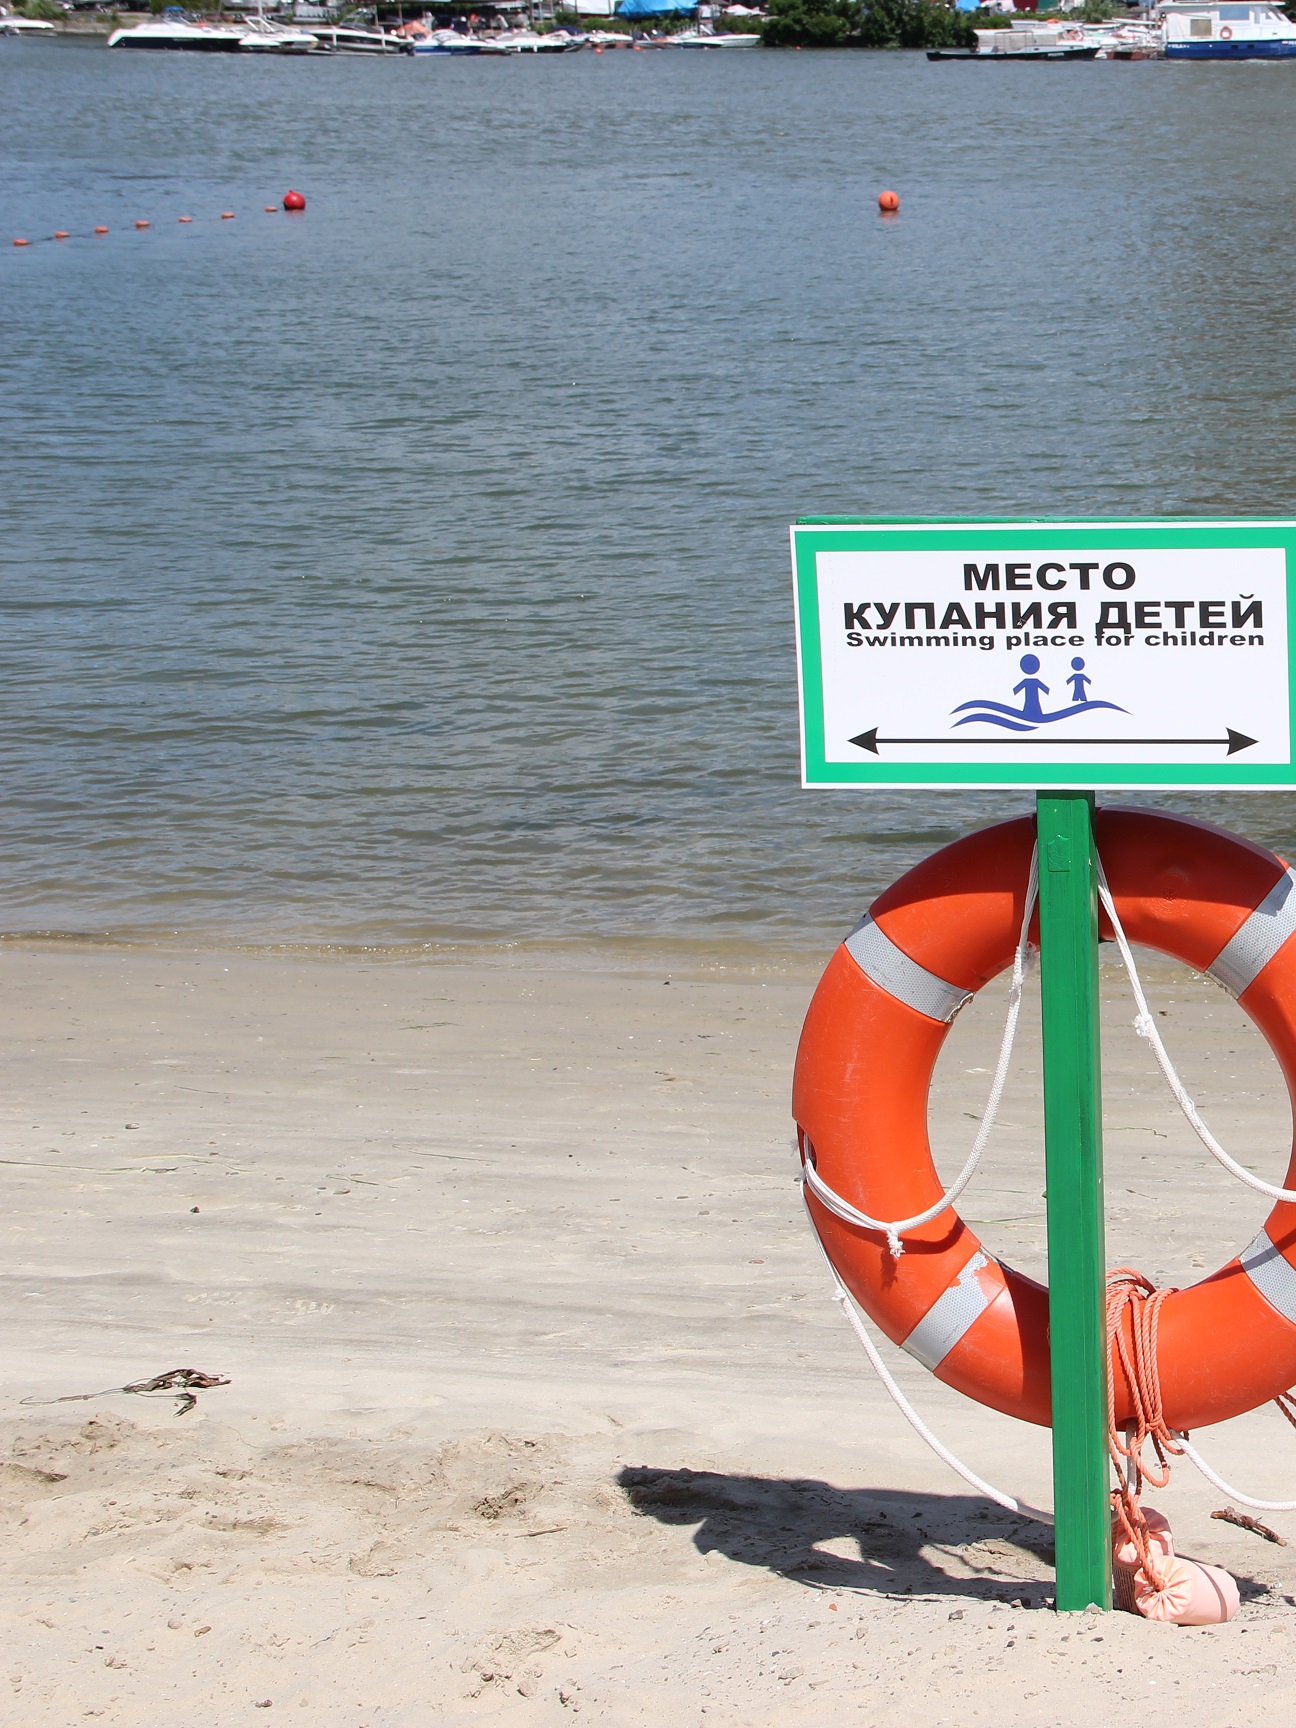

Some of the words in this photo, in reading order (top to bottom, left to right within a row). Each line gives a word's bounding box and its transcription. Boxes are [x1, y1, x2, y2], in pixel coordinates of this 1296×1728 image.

[963, 562, 1136, 591] МЕСТО
[843, 601, 1078, 630] КУПАНИЯ
[1095, 594, 1264, 635] ДЕТЕЙ
[846, 632, 995, 651] Swimming
[1006, 631, 1085, 651] place
[1094, 631, 1135, 647] for
[1144, 631, 1265, 647] children
